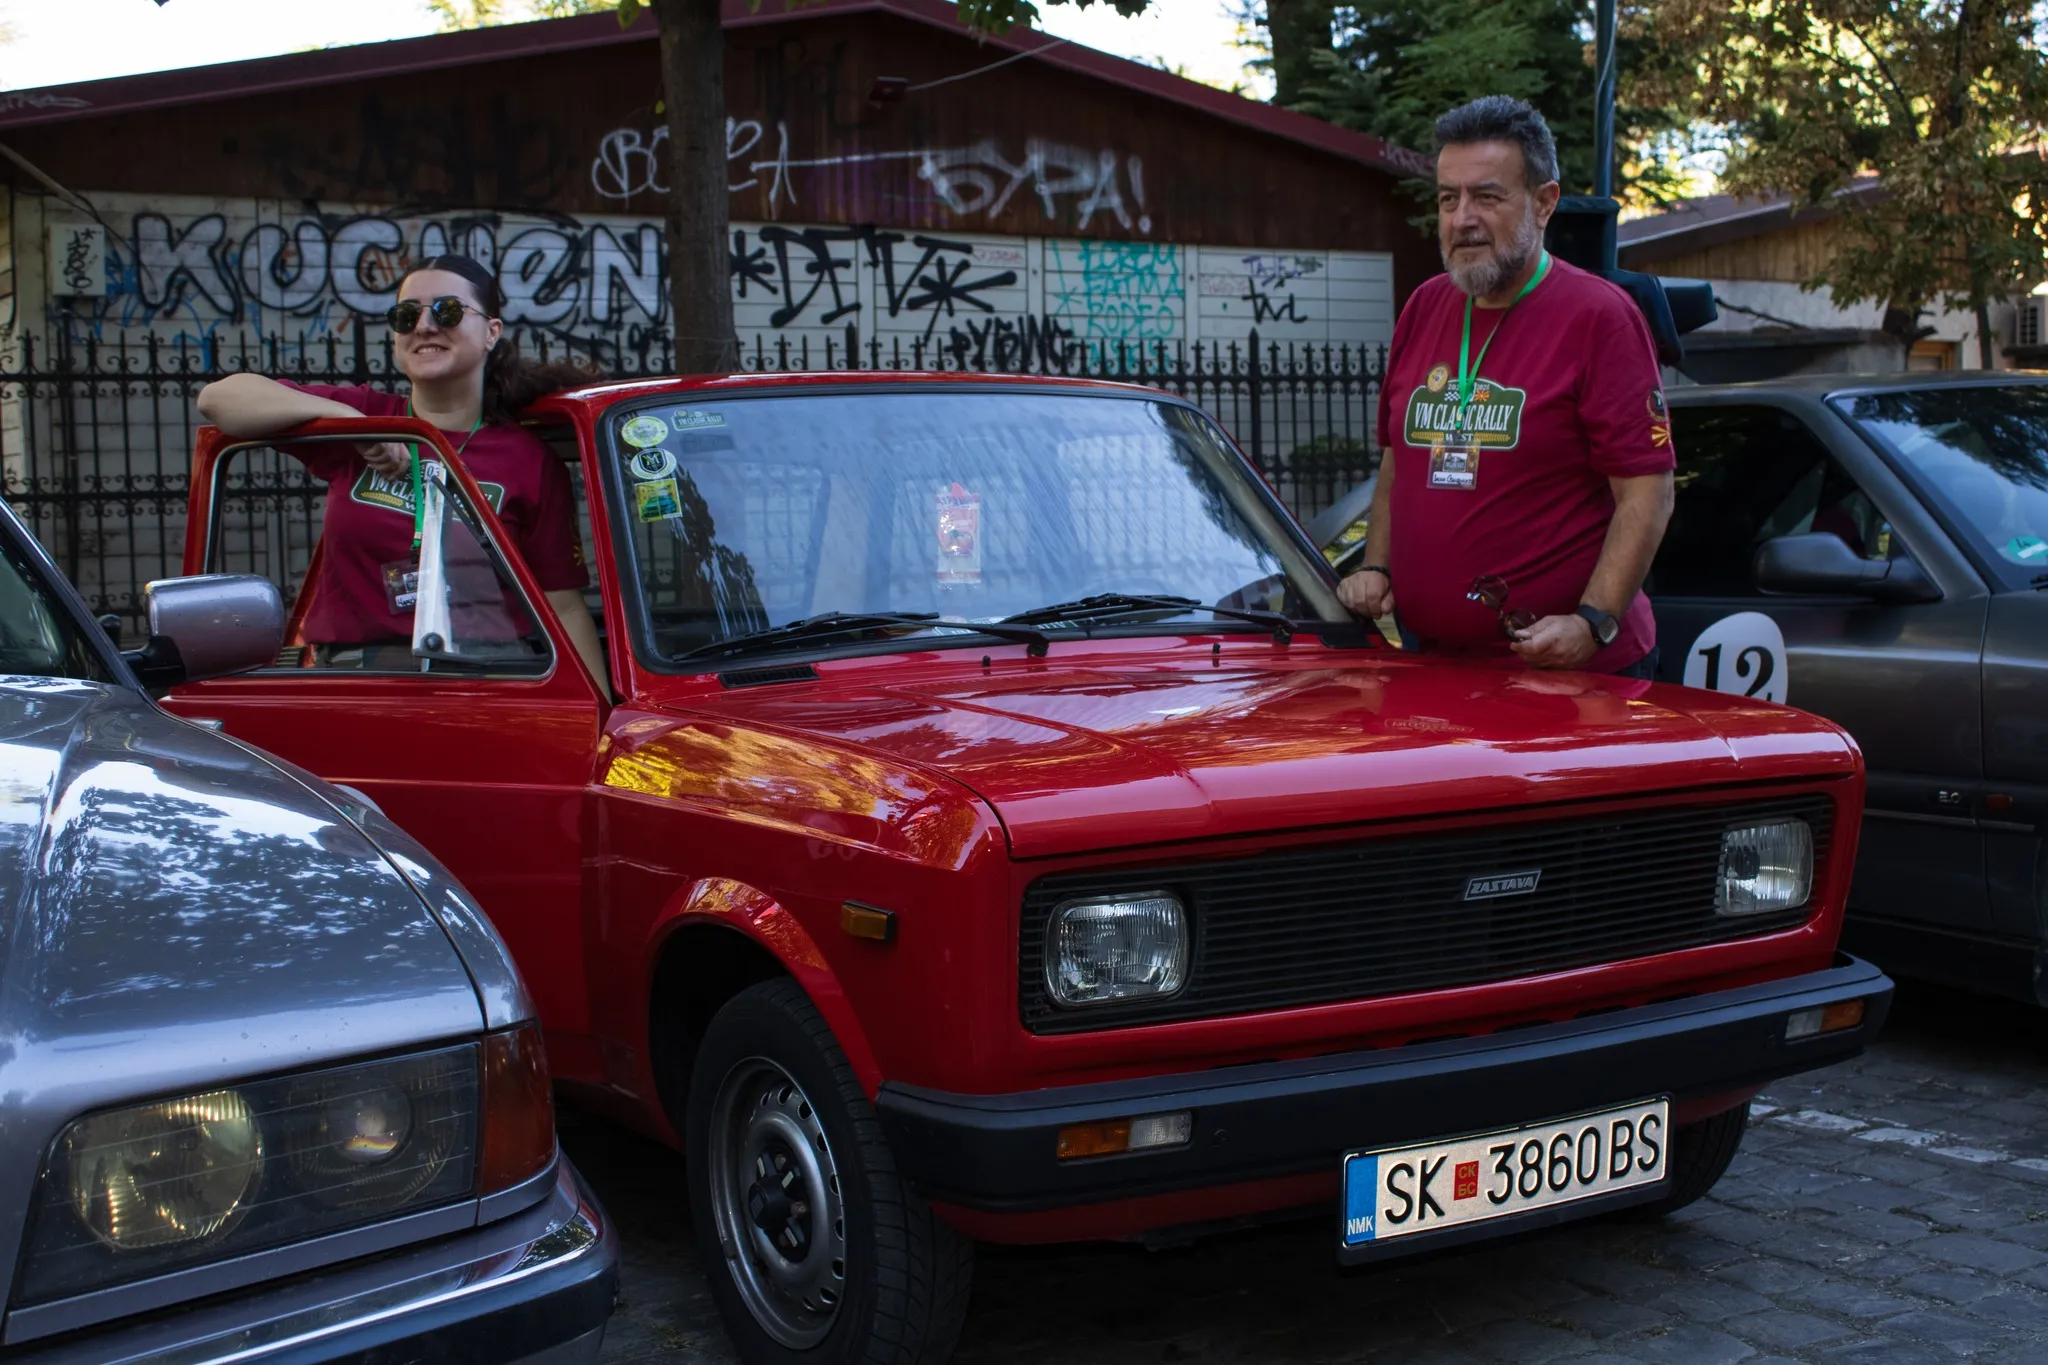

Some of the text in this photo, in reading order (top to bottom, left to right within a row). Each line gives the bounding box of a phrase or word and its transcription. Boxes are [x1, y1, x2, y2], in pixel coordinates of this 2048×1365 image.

[1414, 402, 1515, 431] VM CLAIC RALLY
[1445, 433, 1474, 442] WST
[1698, 643, 1775, 702] 12
[1470, 876, 1534, 894] ZASTAVA
[1384, 1153, 1448, 1225] SK
[1347, 1215, 1374, 1236] NMK
